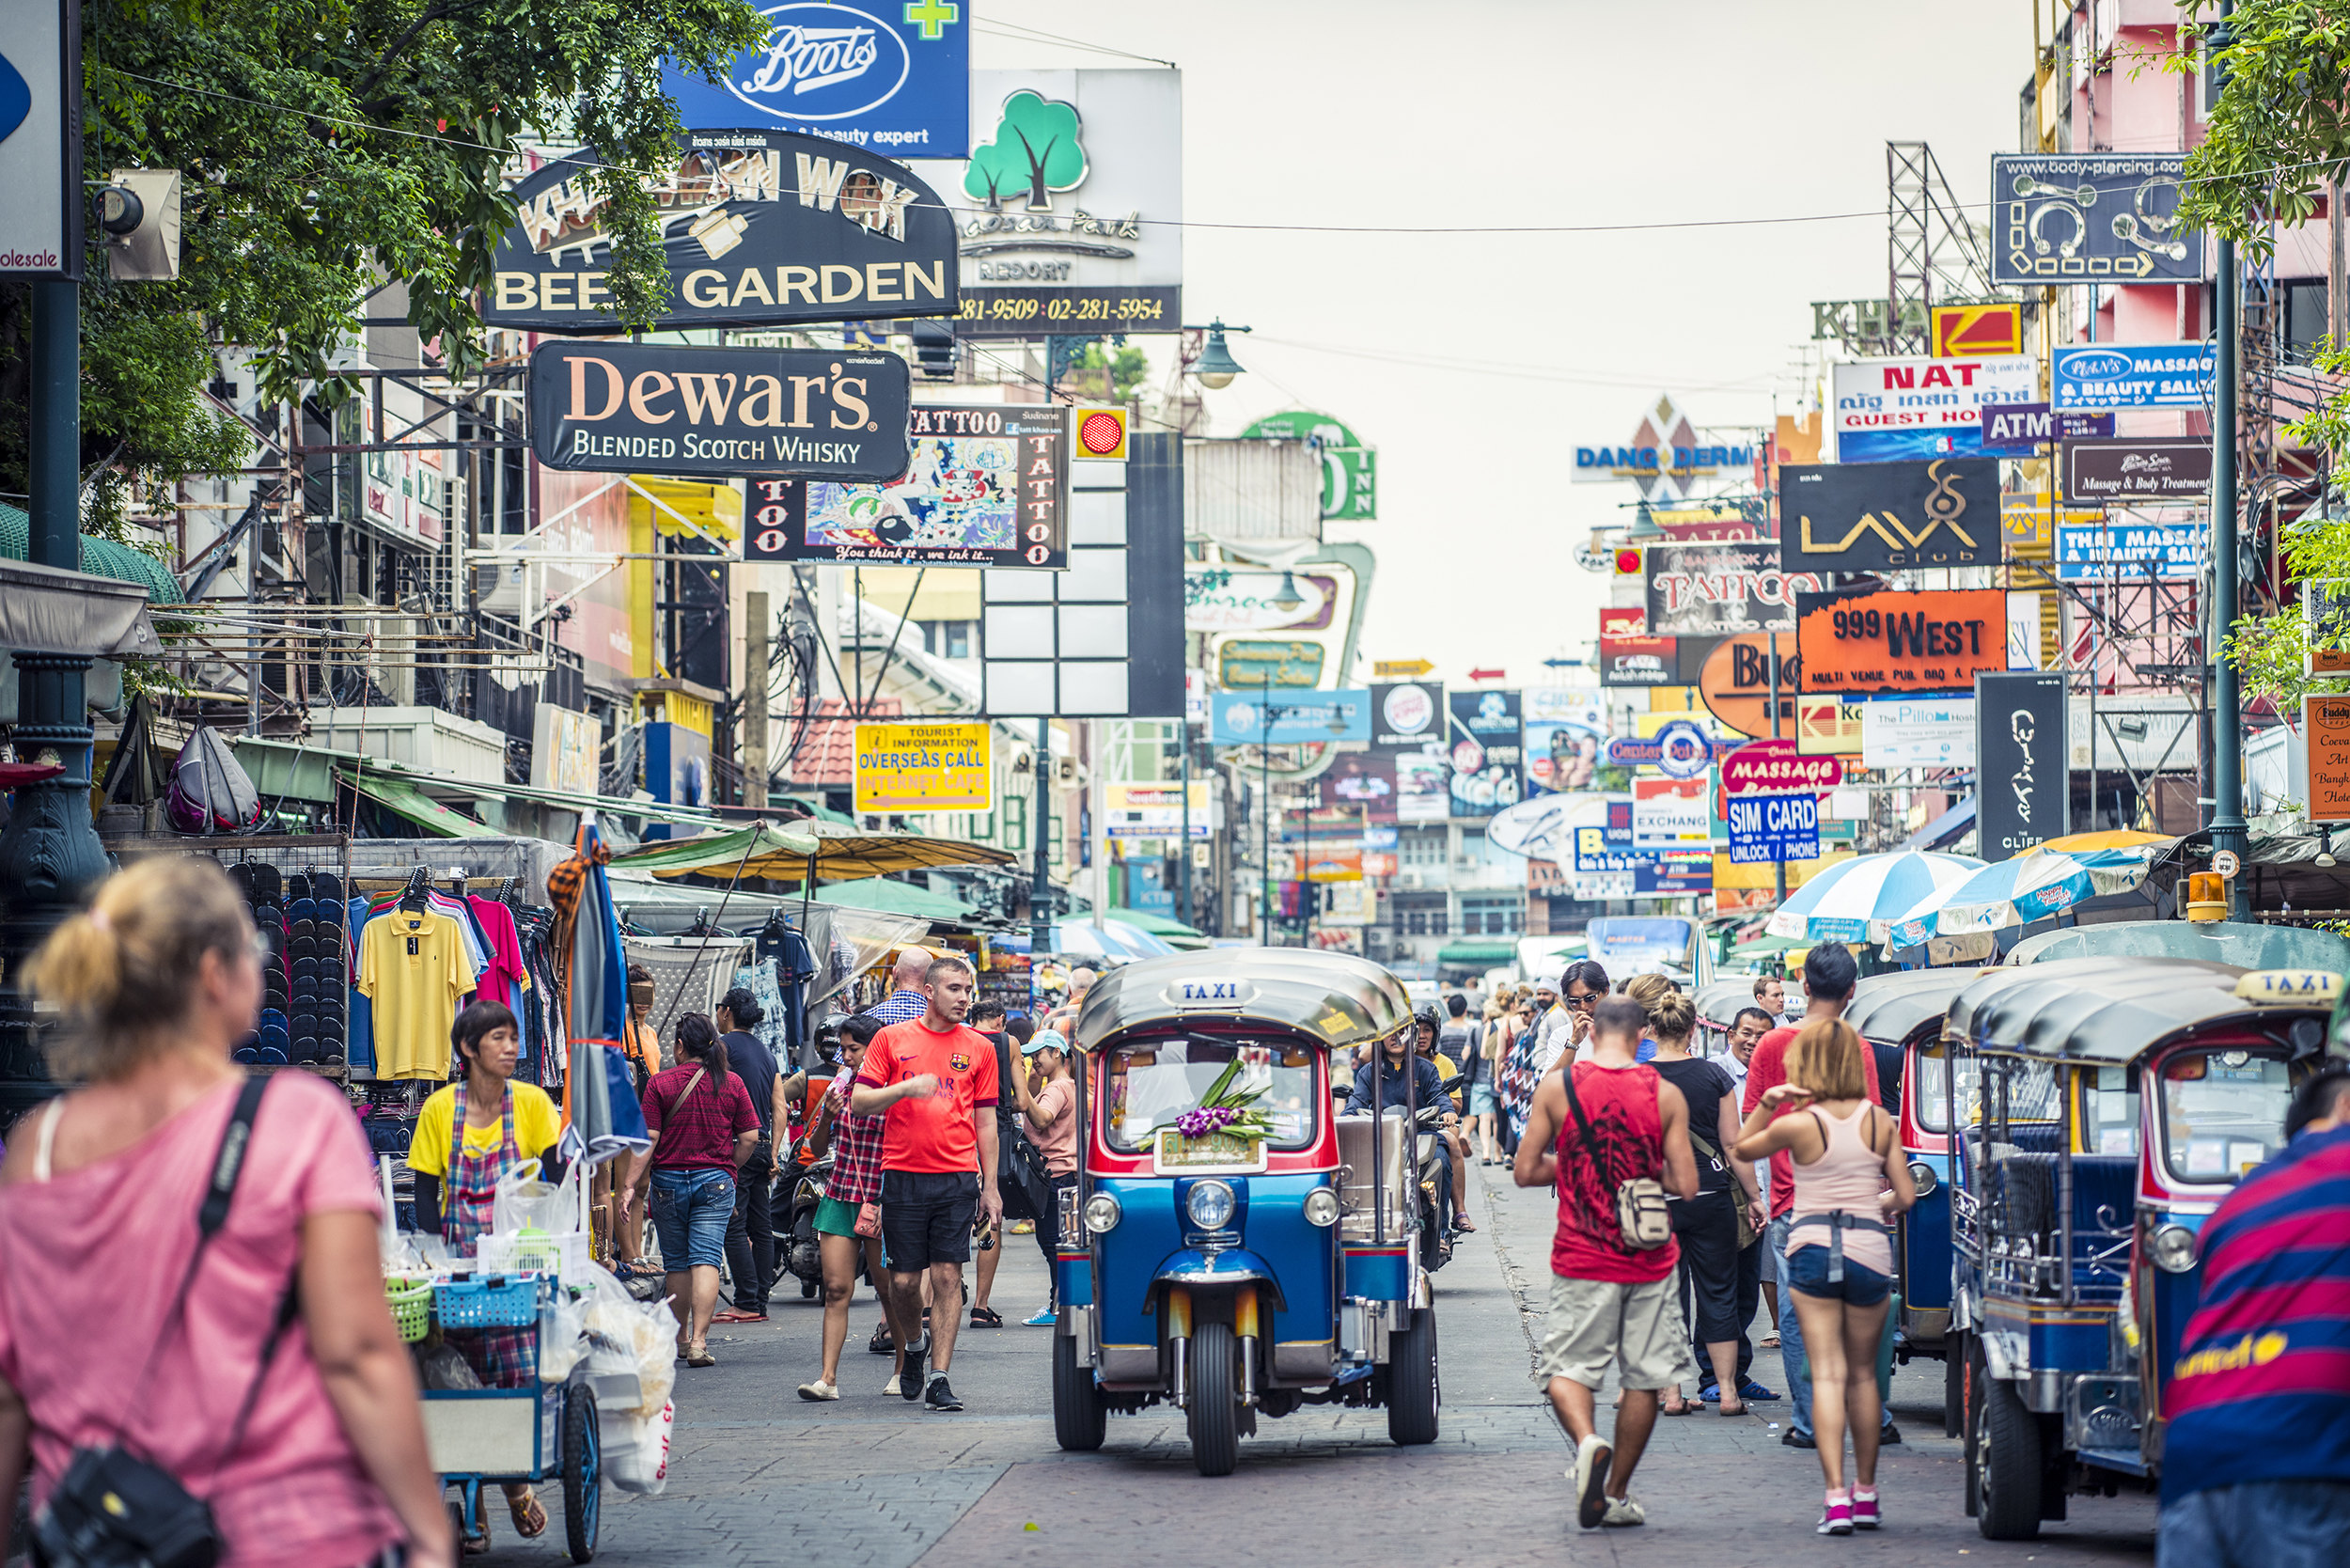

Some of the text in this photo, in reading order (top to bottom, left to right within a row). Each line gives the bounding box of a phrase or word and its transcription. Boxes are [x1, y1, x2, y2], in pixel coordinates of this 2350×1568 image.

[742, 25, 878, 95] Boots
[873, 129, 929, 146] expert
[1069, 208, 1140, 240] Park
[979, 259, 1072, 280] RESORT
[495, 259, 946, 311] BEE GARDEN
[1047, 299, 1164, 320] 02-281-5954
[2134, 358, 2217, 373] MASSAG
[1883, 364, 1982, 389] NAT
[2060, 384, 2076, 396] &
[2082, 381, 2155, 396] BEAUTY
[1845, 413, 1928, 427] GUEST
[1990, 413, 2051, 439] ATM
[573, 429, 861, 464] BLENDED SCOTCH WHISKY
[1576, 447, 1658, 467] DANG
[1354, 451, 1372, 514] INN
[2082, 476, 2210, 493] Massage & Body Treatment
[1025, 434, 1056, 566] TATTOO
[2066, 530, 2116, 548] THAI
[836, 545, 865, 561] You
[868, 545, 902, 559] think
[927, 552, 946, 560] we
[948, 548, 969, 561] ink
[1833, 609, 1984, 657] 999 WEST
[1812, 672, 1843, 683] MULTI
[1851, 670, 1886, 682] VENUE
[1924, 668, 1945, 681] BBQ
[1879, 714, 1897, 723] The
[909, 728, 963, 737] TOURIST
[2321, 734, 2350, 747] Coeva
[893, 738, 979, 748] INFORMATION
[1612, 743, 1662, 759] Center
[1669, 743, 1708, 760] Point
[859, 751, 984, 769] OVERSEAS CALL
[2326, 753, 2349, 766] Art
[1731, 760, 1833, 781] MASSAGE
[860, 774, 985, 792] INTERNET CAFE
[2314, 772, 2350, 788] Bangk
[1125, 790, 1183, 806] Southeas
[1730, 802, 1762, 834] SIM
[1767, 799, 1816, 832] CARD
[1731, 844, 1771, 861] UNLOCK
[1786, 841, 1818, 858] PHONE
[2037, 886, 2063, 900] Happy
[2042, 889, 2071, 905] Tourist
[1183, 982, 1236, 999] TAXI
[2262, 975, 2328, 990] TAXI
